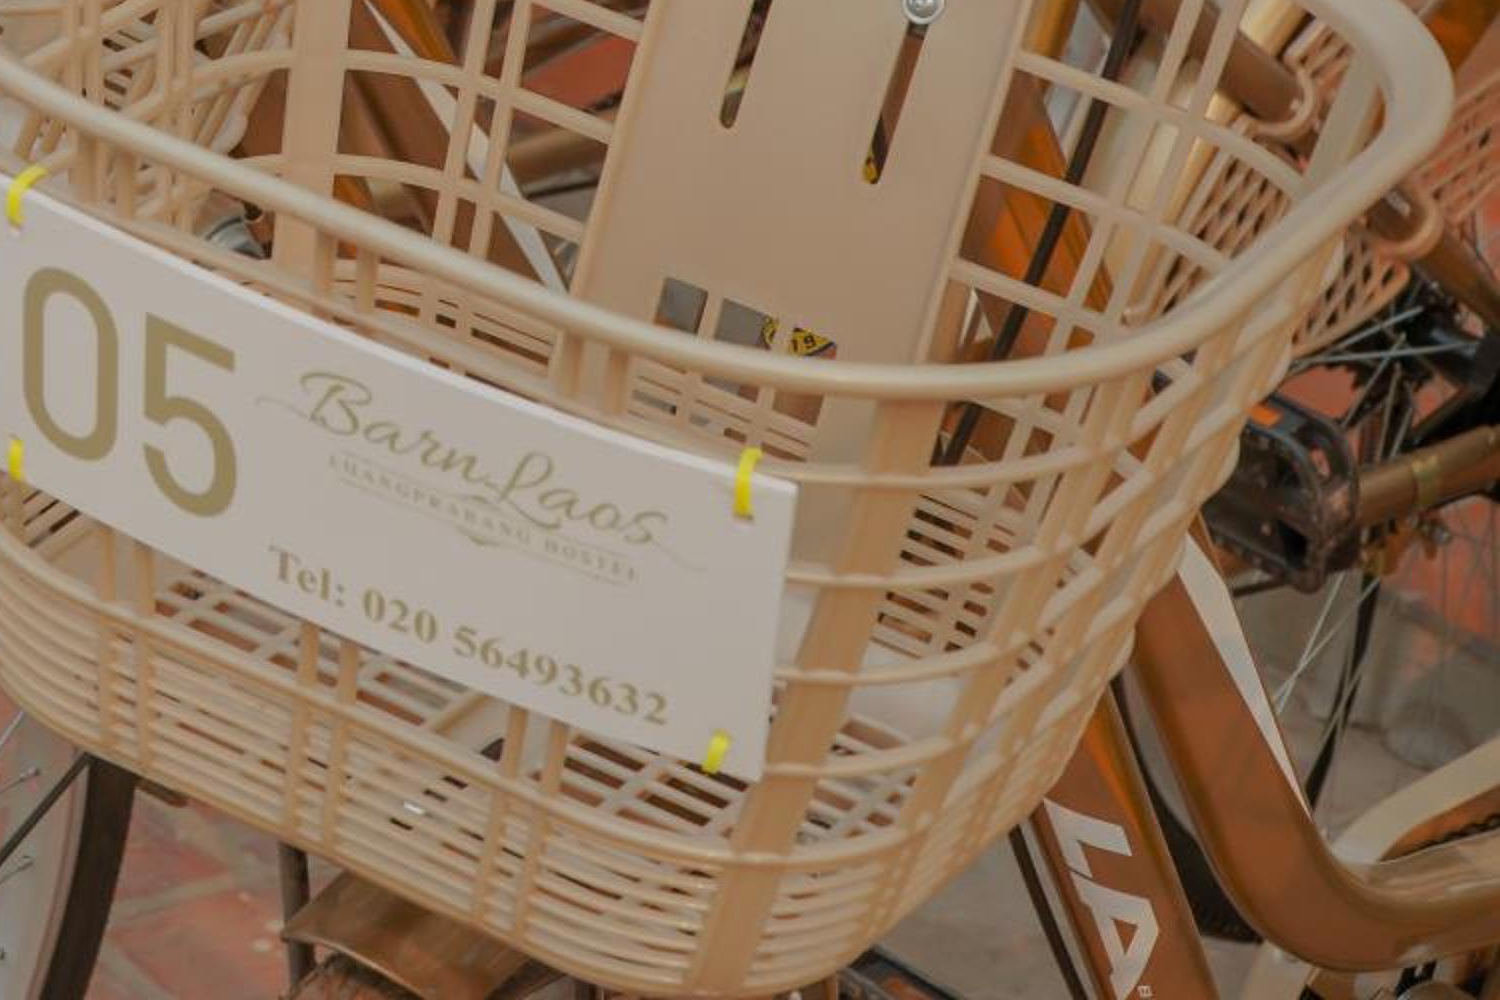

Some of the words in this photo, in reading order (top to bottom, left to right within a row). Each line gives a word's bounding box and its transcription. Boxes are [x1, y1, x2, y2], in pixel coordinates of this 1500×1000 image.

[22, 267, 237, 518] 05
[268, 544, 345, 608] Tel:
[362, 588, 438, 644] 020
[453, 624, 667, 726] 56493632
